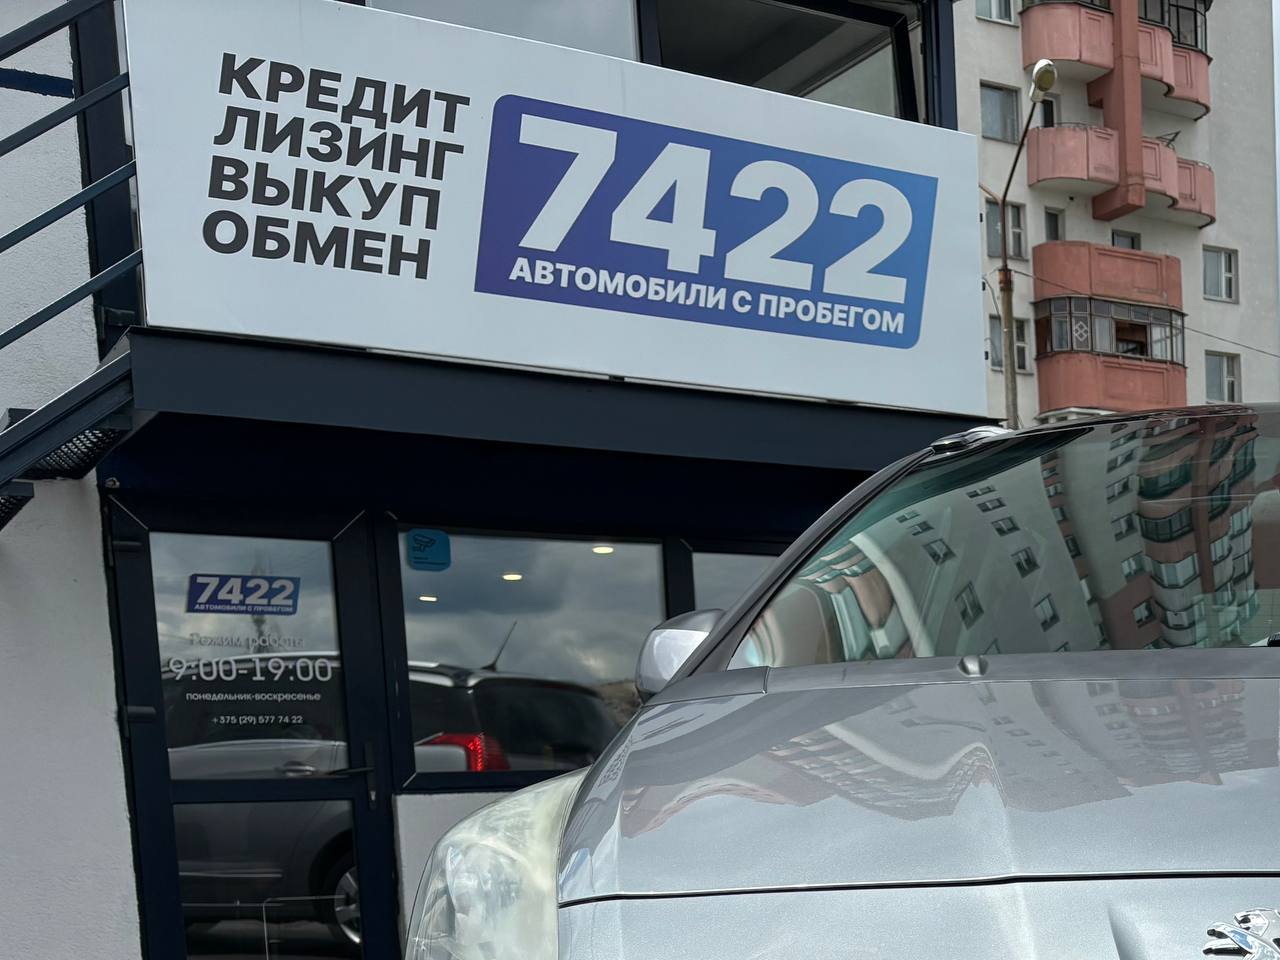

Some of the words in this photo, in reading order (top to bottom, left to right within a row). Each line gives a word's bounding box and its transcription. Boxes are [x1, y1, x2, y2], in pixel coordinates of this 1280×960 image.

[218, 52, 471, 134] КРЕДИТ
[213, 105, 465, 181] ЛИЗИНГ
[207, 155, 441, 231] ВЫКУП
[518, 113, 914, 305] 7422
[202, 209, 431, 280] ОБМЕН
[508, 257, 727, 311] АВТОМОБИЛИ
[731, 290, 752, 314] С
[758, 293, 905, 335] ПРОБЕГОМ
[196, 576, 294, 606] 7422
[168, 657, 333, 682] 9:00-19:00
[186, 691, 321, 703] понедельник-воскресенье
[212, 715, 237, 725] +375
[258, 715, 276, 724] 577
[278, 715, 290, 724] 74
[291, 715, 303, 724] 22
